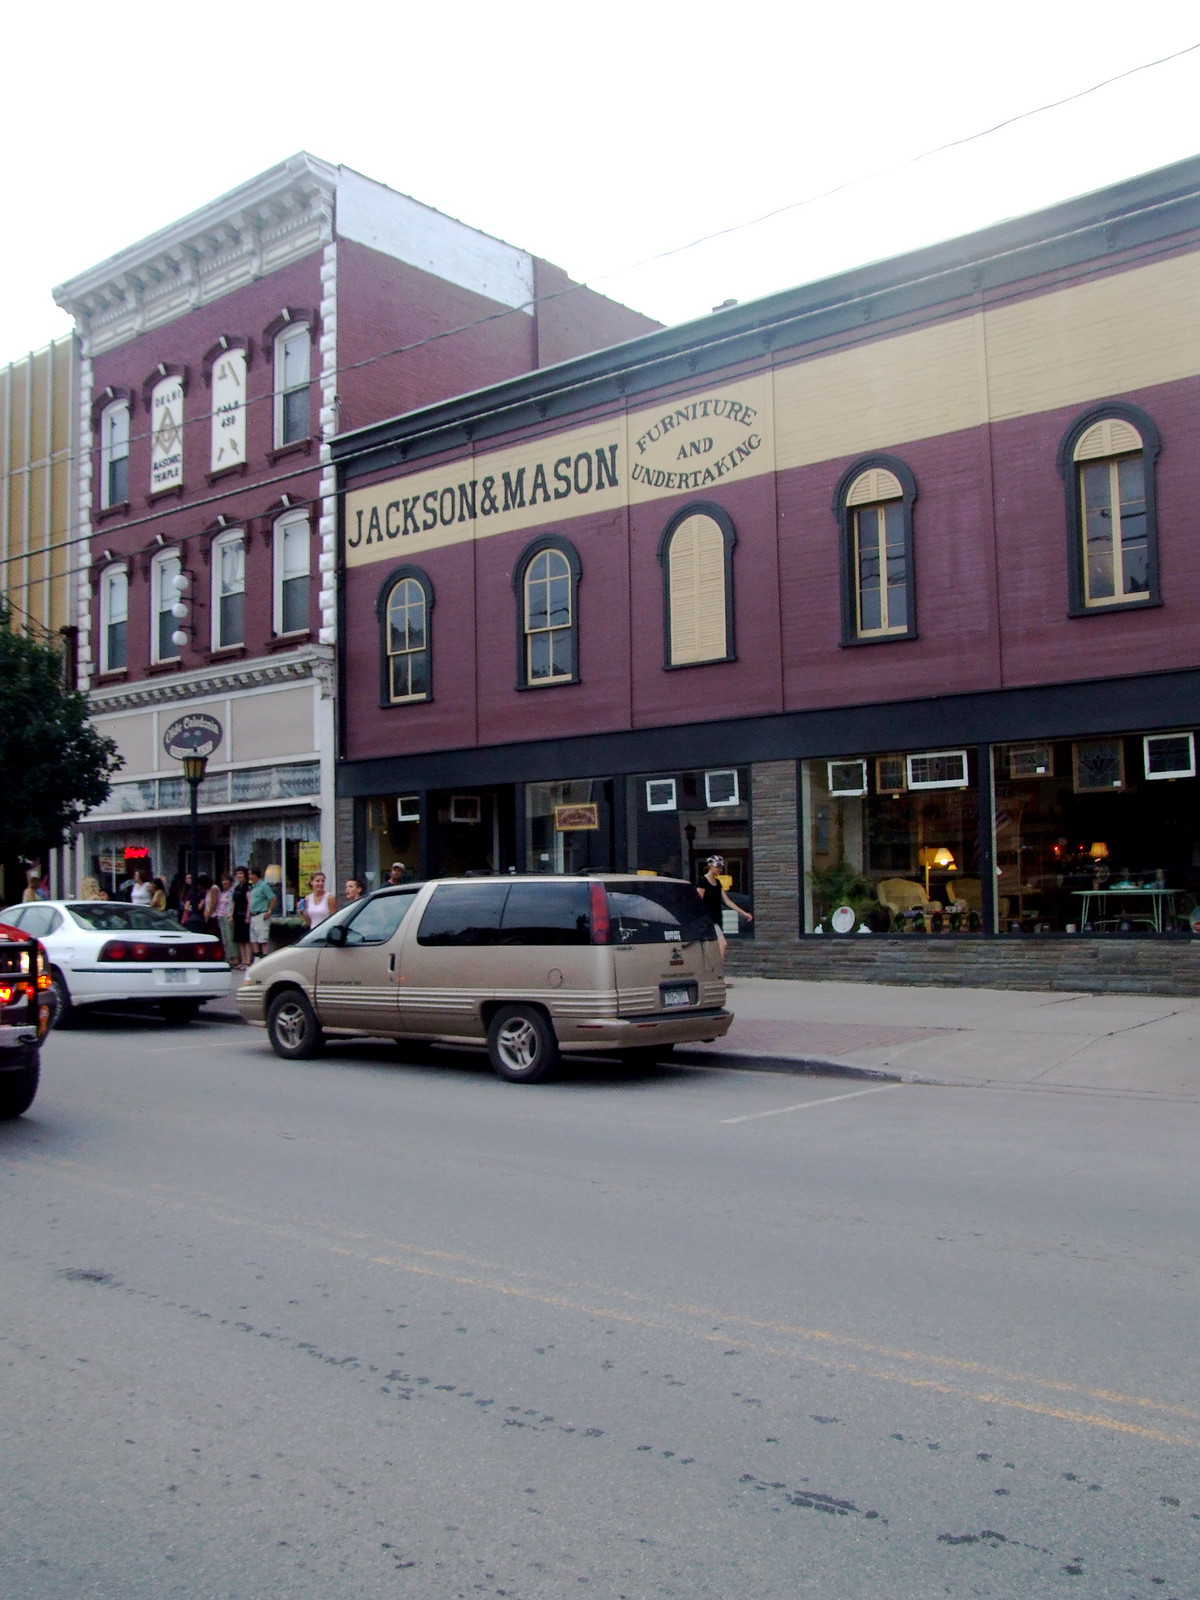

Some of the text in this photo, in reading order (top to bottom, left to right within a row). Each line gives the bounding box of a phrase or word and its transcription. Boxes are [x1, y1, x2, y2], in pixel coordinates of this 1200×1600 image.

[636, 398, 758, 455] FURNITURE
[676, 436, 714, 460] AND
[631, 432, 762, 490] UNDERTAKING
